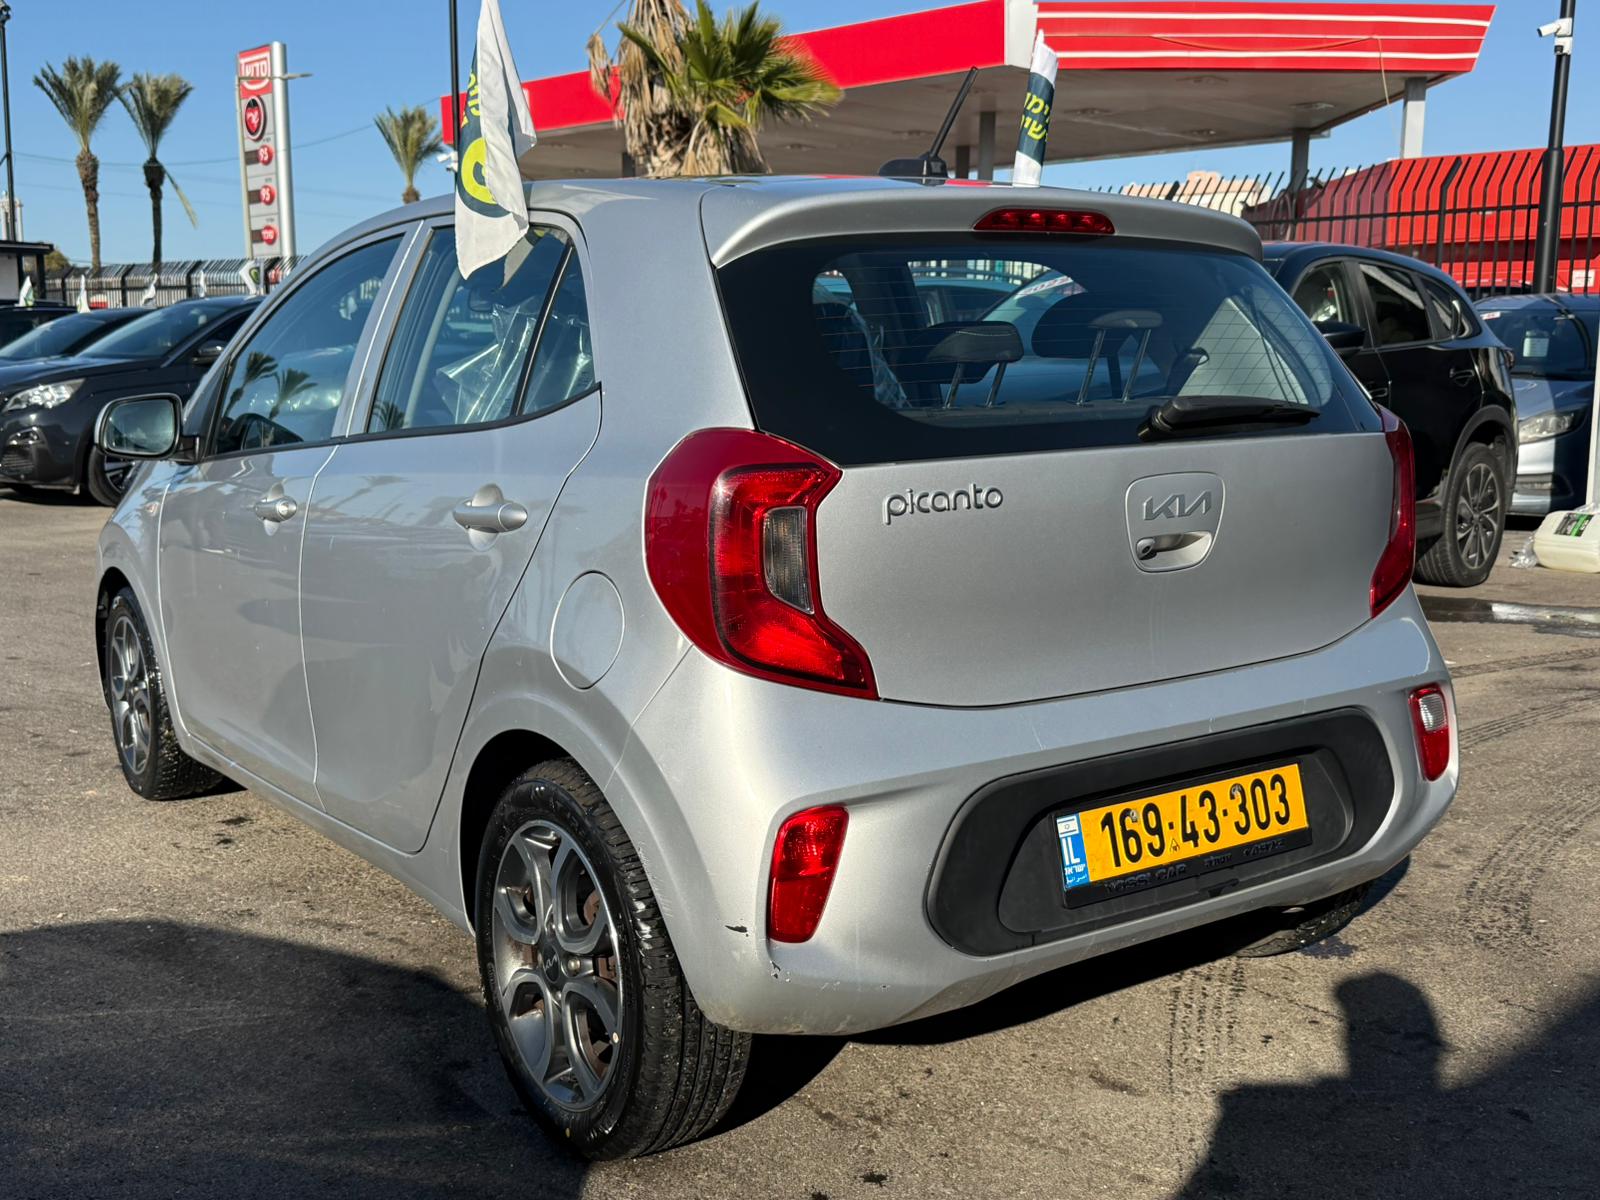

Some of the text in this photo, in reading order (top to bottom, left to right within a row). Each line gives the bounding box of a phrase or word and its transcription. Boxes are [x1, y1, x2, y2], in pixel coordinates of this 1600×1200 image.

[882, 483, 1004, 525] picanto
[1143, 490, 1212, 521] KIA
[1061, 836, 1081, 866] IL
